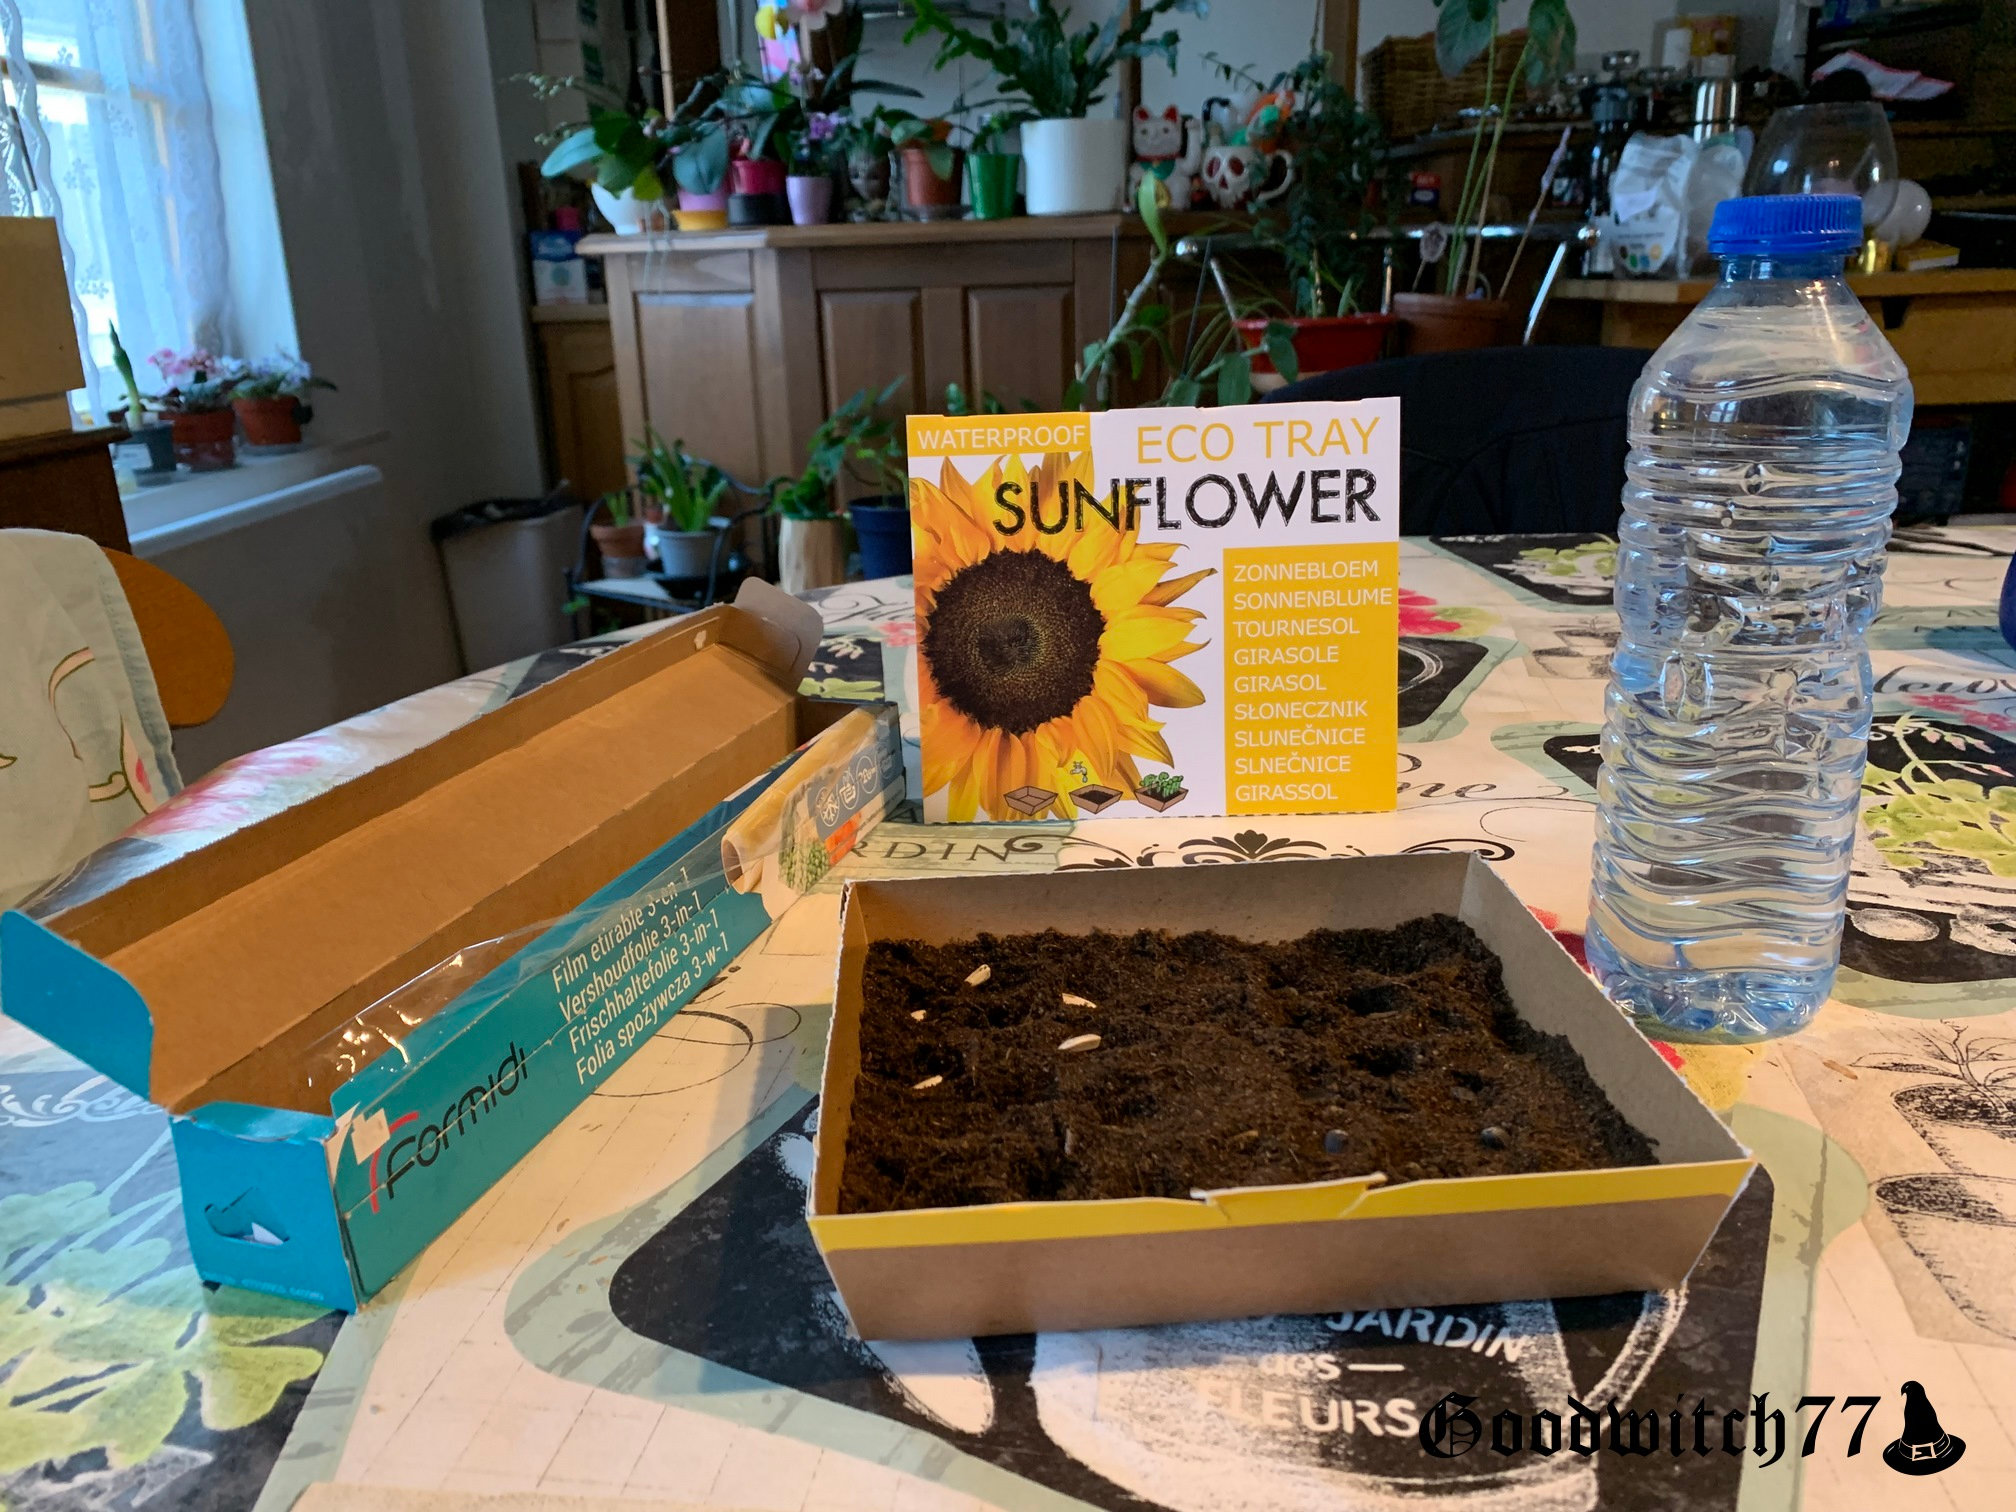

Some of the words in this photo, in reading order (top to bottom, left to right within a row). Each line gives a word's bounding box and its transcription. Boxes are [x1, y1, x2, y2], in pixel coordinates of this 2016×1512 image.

[917, 425, 1087, 450] WATERPROOF
[1137, 422, 1234, 464] ECO
[1253, 416, 1380, 459] TRAY
[994, 468, 1382, 537] SUNFLOWER
[1233, 560, 1379, 583] ZONNEBLOEM
[1233, 588, 1392, 610] SONNENBLUME
[1232, 617, 1360, 638] TOURNESOL
[1233, 646, 1339, 666] GIRASOLE
[1233, 674, 1327, 693] GIRASOL
[1234, 700, 1368, 721] SŁONECZNIK
[1234, 724, 1366, 748] SLUNEČNICE
[1234, 751, 1351, 775] SLNEČNICE
[1235, 783, 1338, 802] GIRASSOL
[552, 955, 588, 993] Film
[647, 866, 690, 916] 3-en1
[559, 927, 660, 1023] Vershoudfolie
[660, 890, 702, 938] 3-in-1
[569, 946, 679, 1054] Frischhaltefolie
[680, 908, 719, 956] 3-in-1
[576, 1040, 616, 1085] Folia
[617, 973, 691, 1047] spożywcza
[691, 932, 729, 978] 3-w-1
